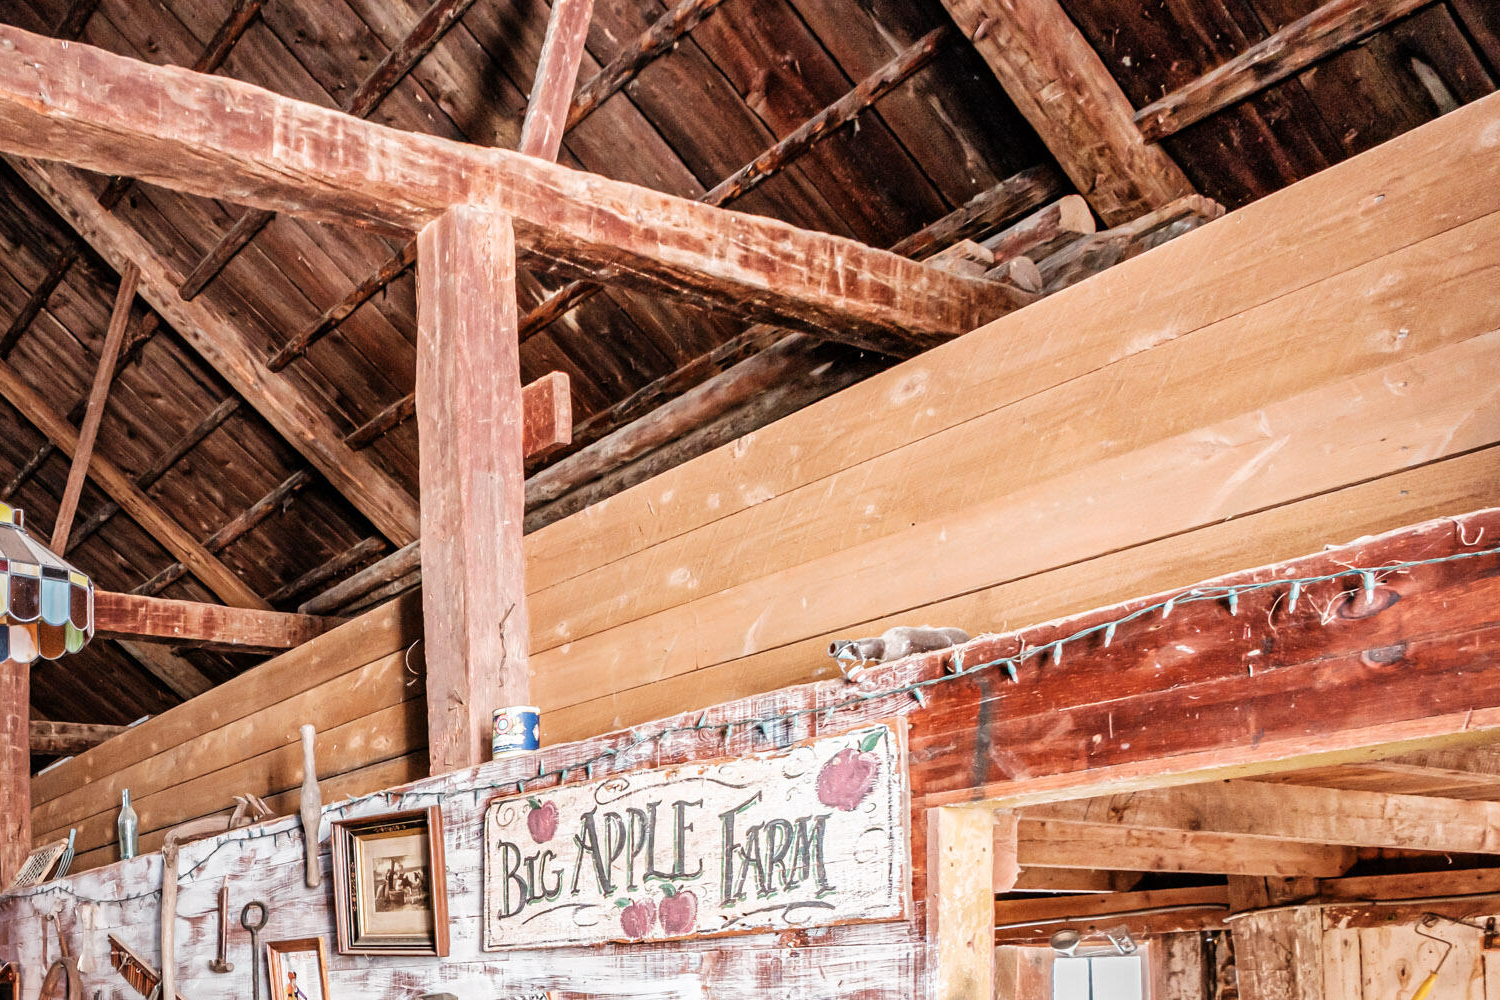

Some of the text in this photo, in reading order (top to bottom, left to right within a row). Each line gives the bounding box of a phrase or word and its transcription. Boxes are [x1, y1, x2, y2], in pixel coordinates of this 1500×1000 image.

[497, 790, 837, 920] BIG APPLE FARM
